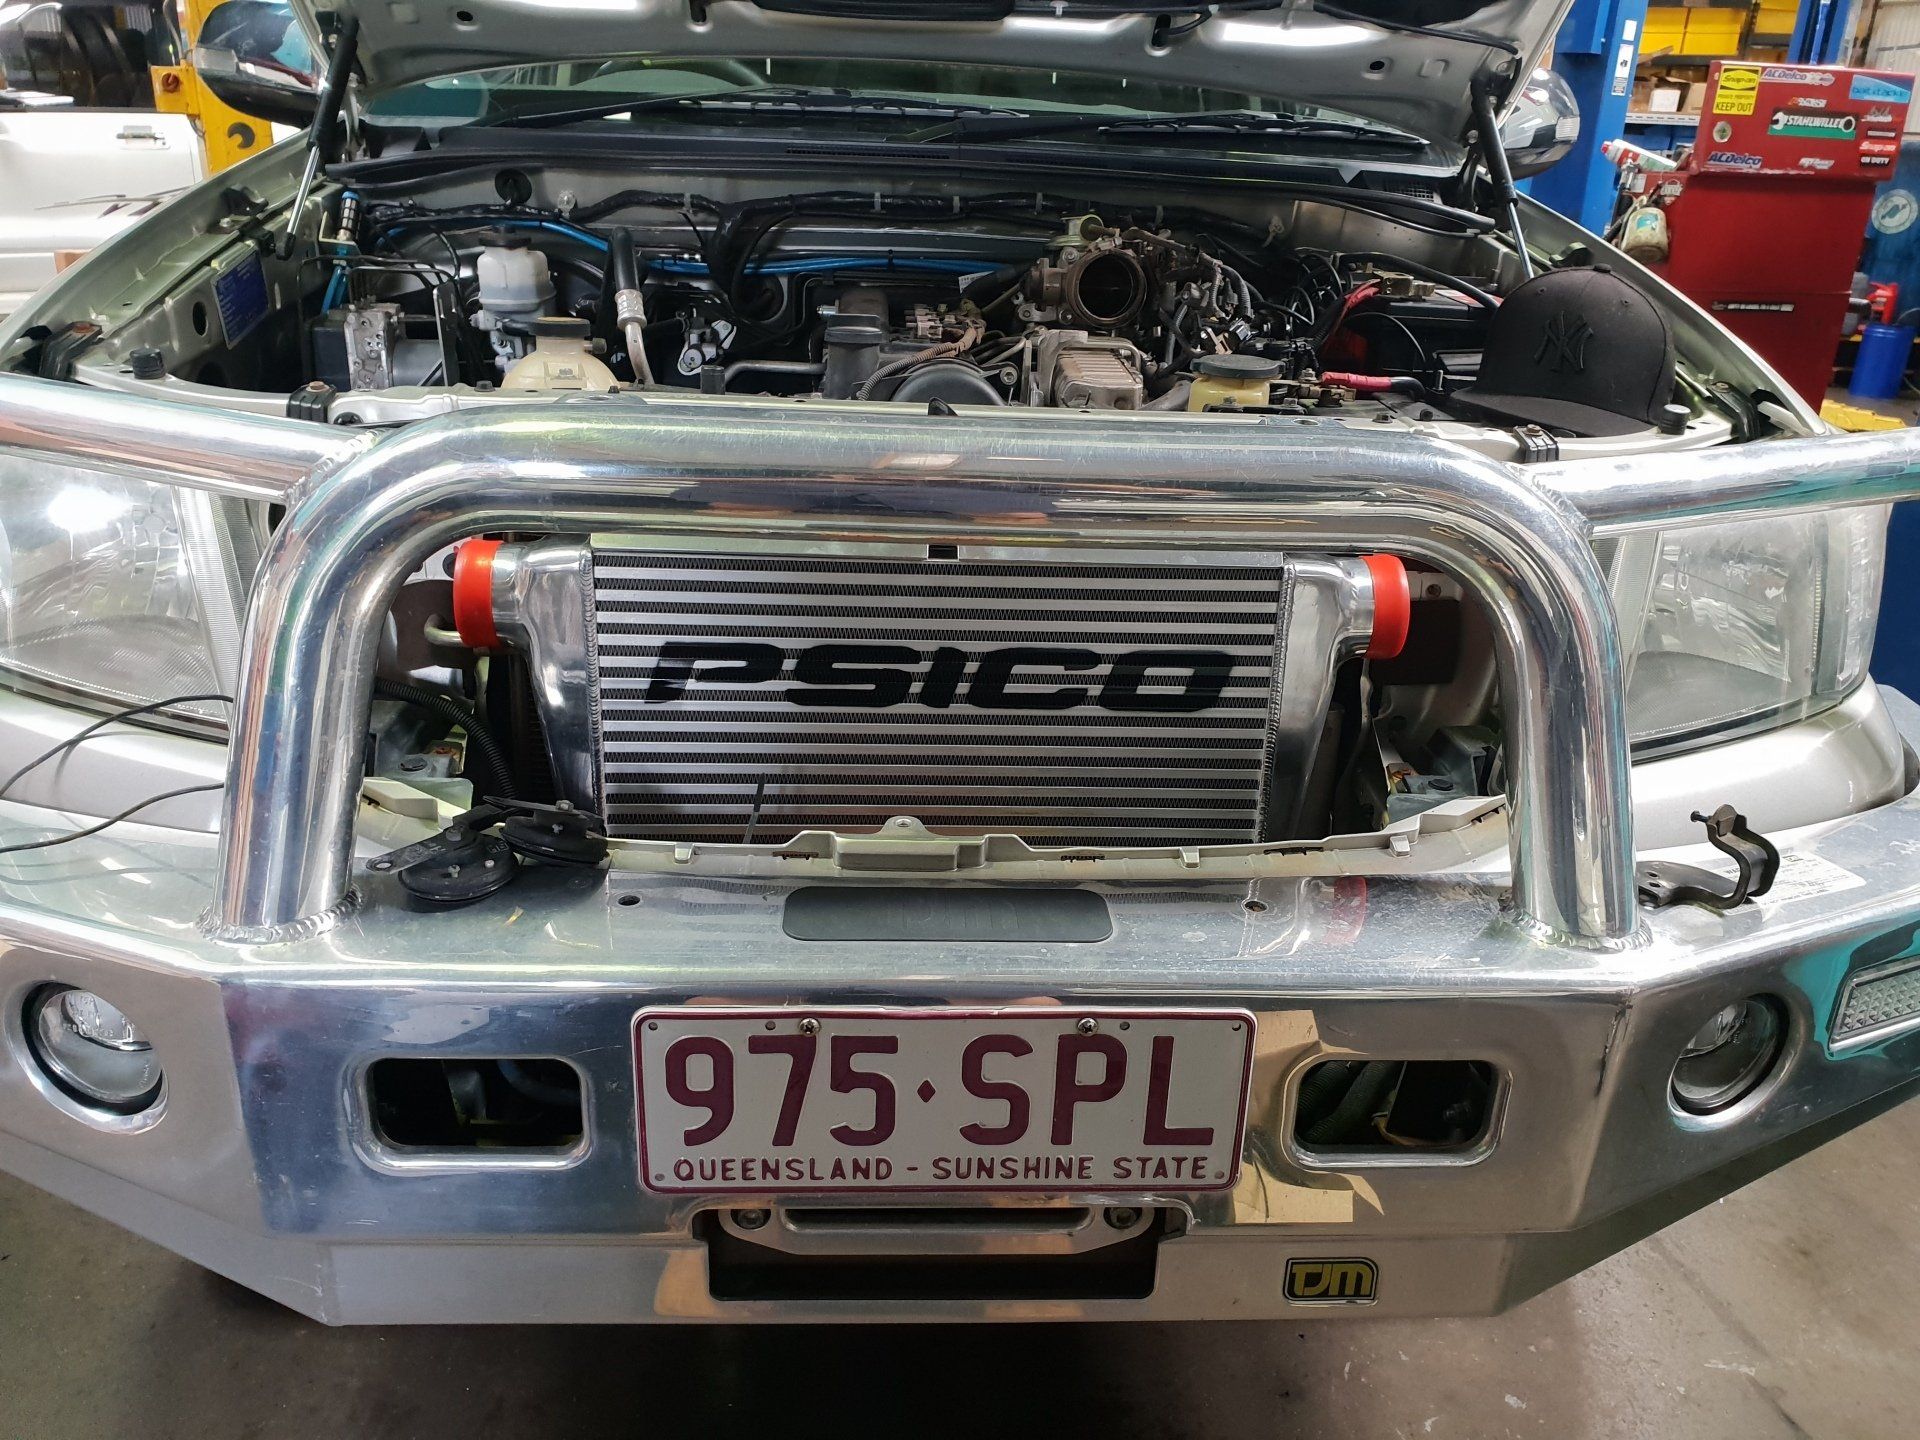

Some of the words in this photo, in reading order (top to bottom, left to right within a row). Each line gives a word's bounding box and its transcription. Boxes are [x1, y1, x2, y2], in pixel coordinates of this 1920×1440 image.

[1764, 69, 1807, 80] ACDelco
[1716, 102, 1736, 111] KEEP
[1736, 103, 1753, 112] OUT
[1786, 115, 1843, 128] STAHLWILLE
[1708, 152, 1761, 165] ACDelco
[645, 641, 1235, 712] PSICO
[673, 1157, 893, 1181] QUEENSLAND
[932, 1156, 1094, 1180] SUNSHINE
[1112, 1156, 1209, 1180] STATE
